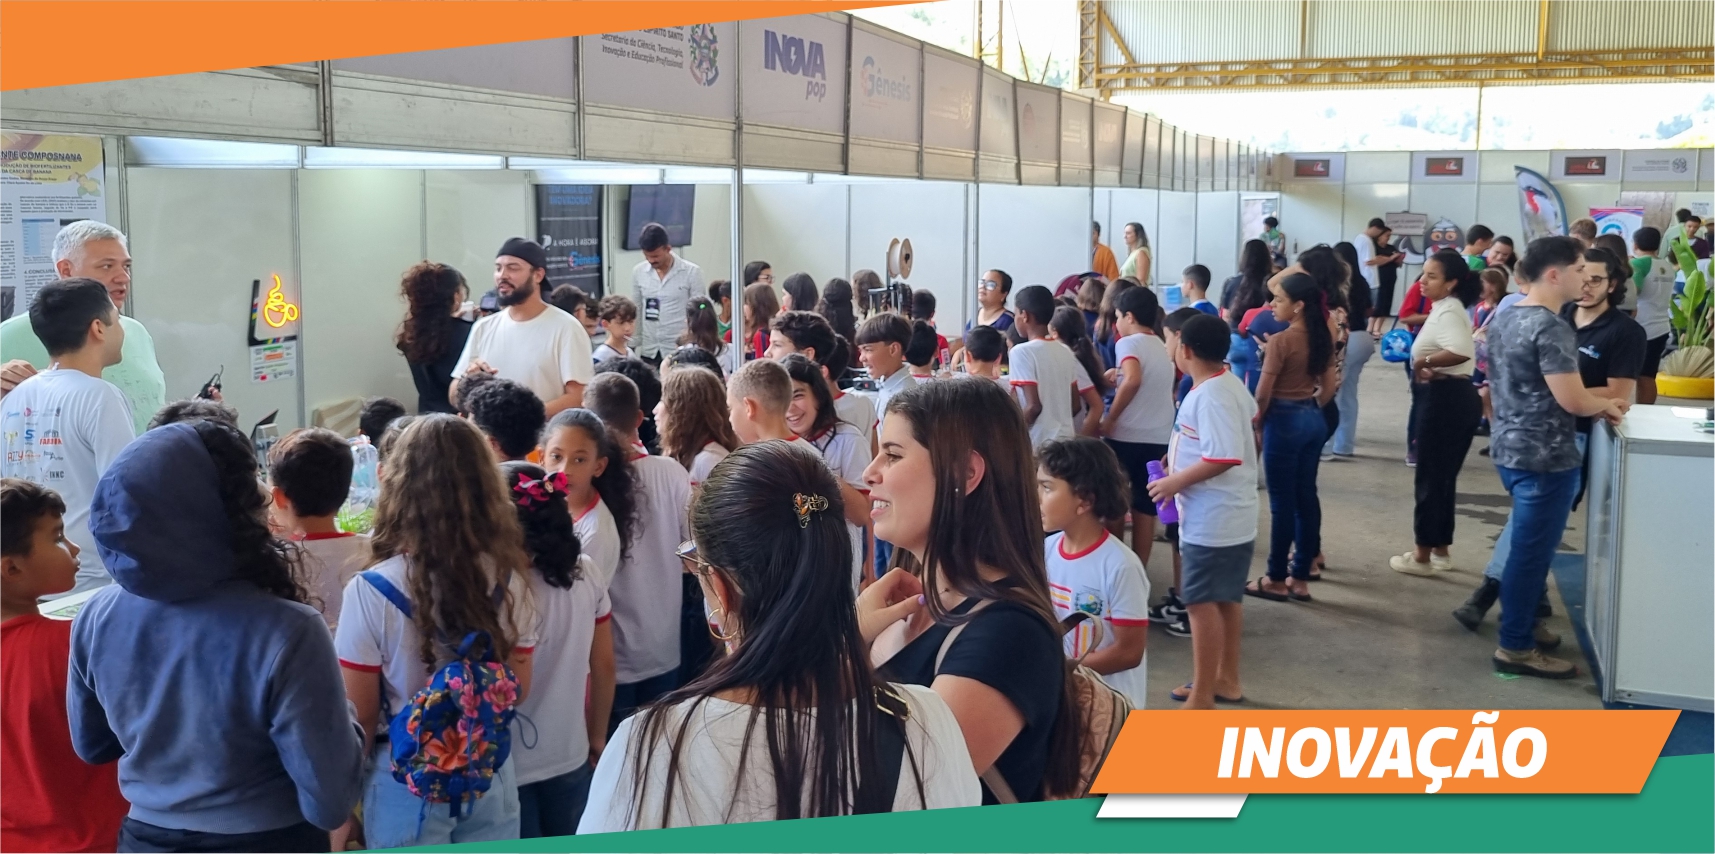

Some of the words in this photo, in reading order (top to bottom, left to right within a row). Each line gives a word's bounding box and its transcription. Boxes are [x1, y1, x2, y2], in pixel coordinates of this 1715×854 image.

[601, 33, 629, 45] Secretaria
[629, 38, 637, 47] da
[668, 30, 684, 41] SANTO
[602, 44, 626, 58] Inovação
[631, 50, 655, 64] Educação
[656, 56, 683, 69] Profissional
[764, 29, 826, 81] INOVA
[861, 56, 911, 101] Gênesis
[805, 80, 826, 103] pop
[20, 151, 83, 162] COMPOSNANA
